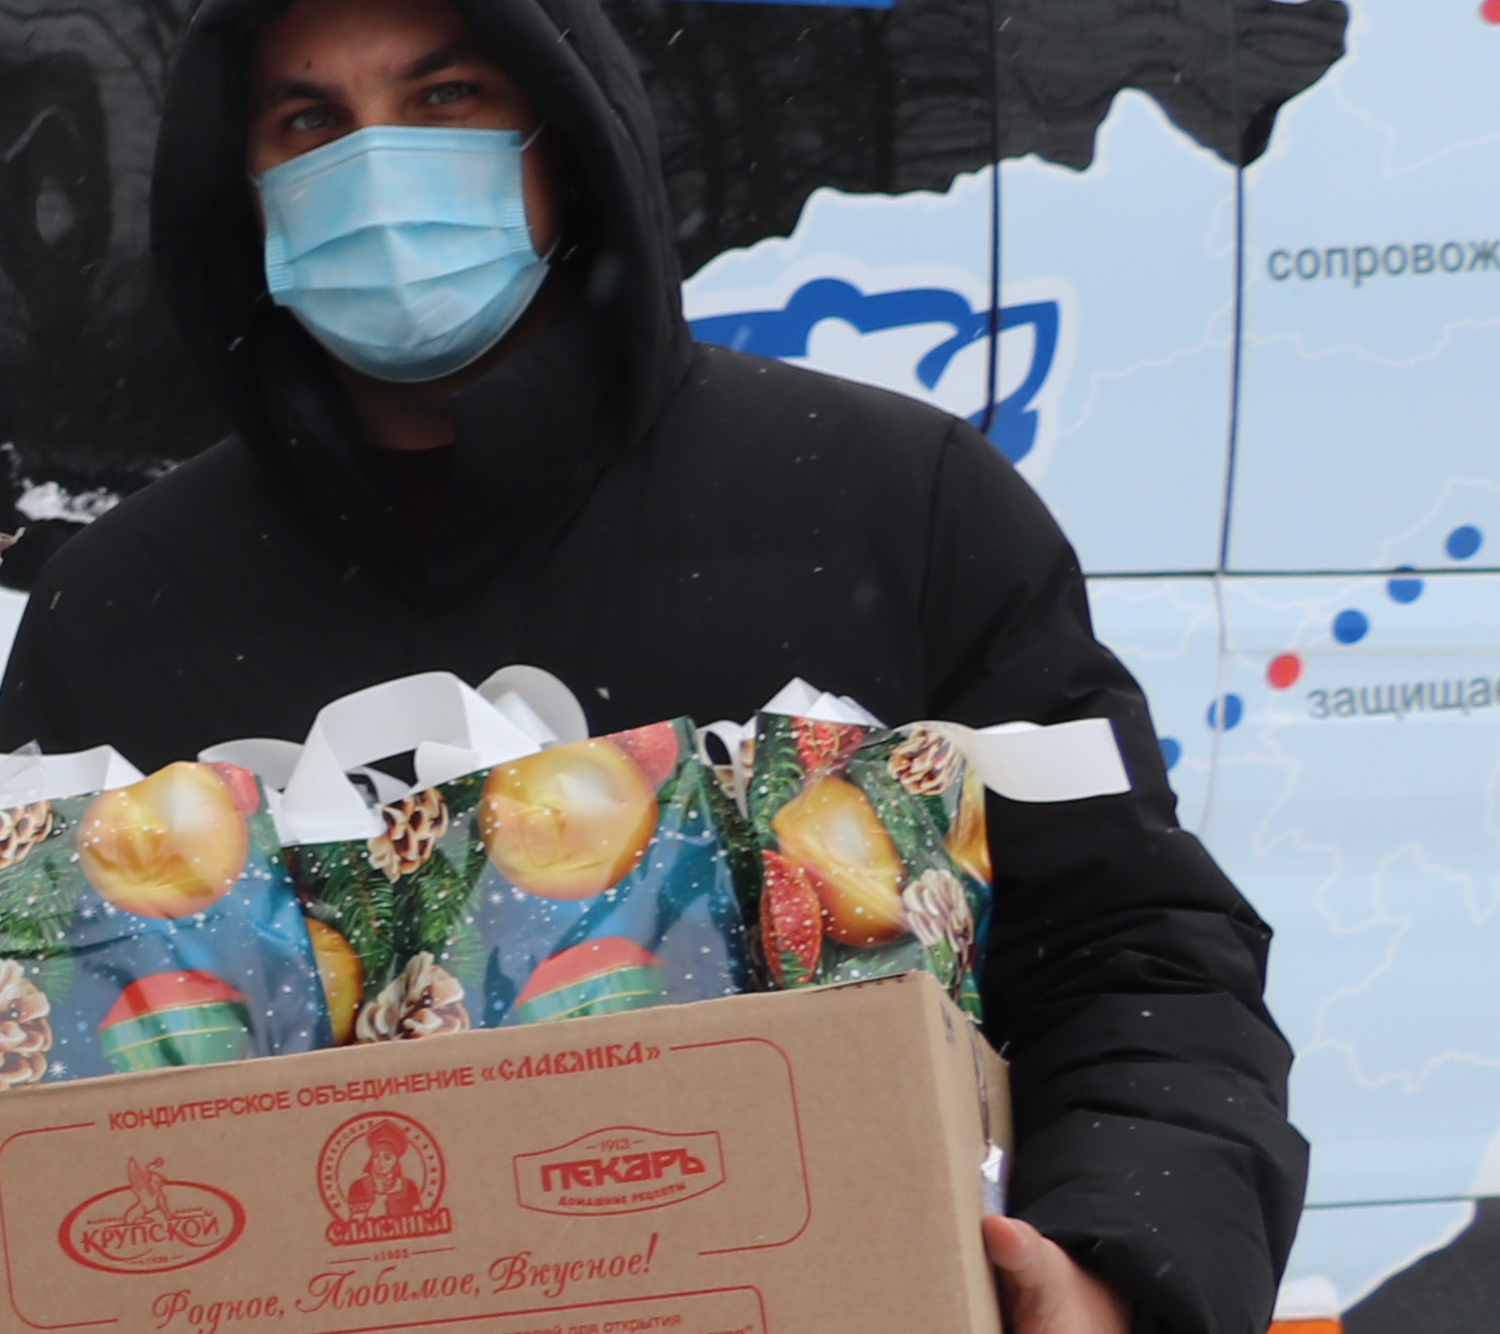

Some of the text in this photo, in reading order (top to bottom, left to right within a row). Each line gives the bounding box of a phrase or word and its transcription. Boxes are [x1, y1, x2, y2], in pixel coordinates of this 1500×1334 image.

[108, 1089, 291, 1133] КОНДИТЕРСКОЕ
[296, 1066, 476, 1108] ОБЪЕДИНЕНИЕ
[541, 1148, 706, 1192] ПЕКАРЬ
[80, 1211, 220, 1254] КРУПСКОЙ
[295, 1266, 481, 1314] Любимое,
[488, 1233, 659, 1299] Вкусное!
[603, 1314, 682, 1334] открытия
